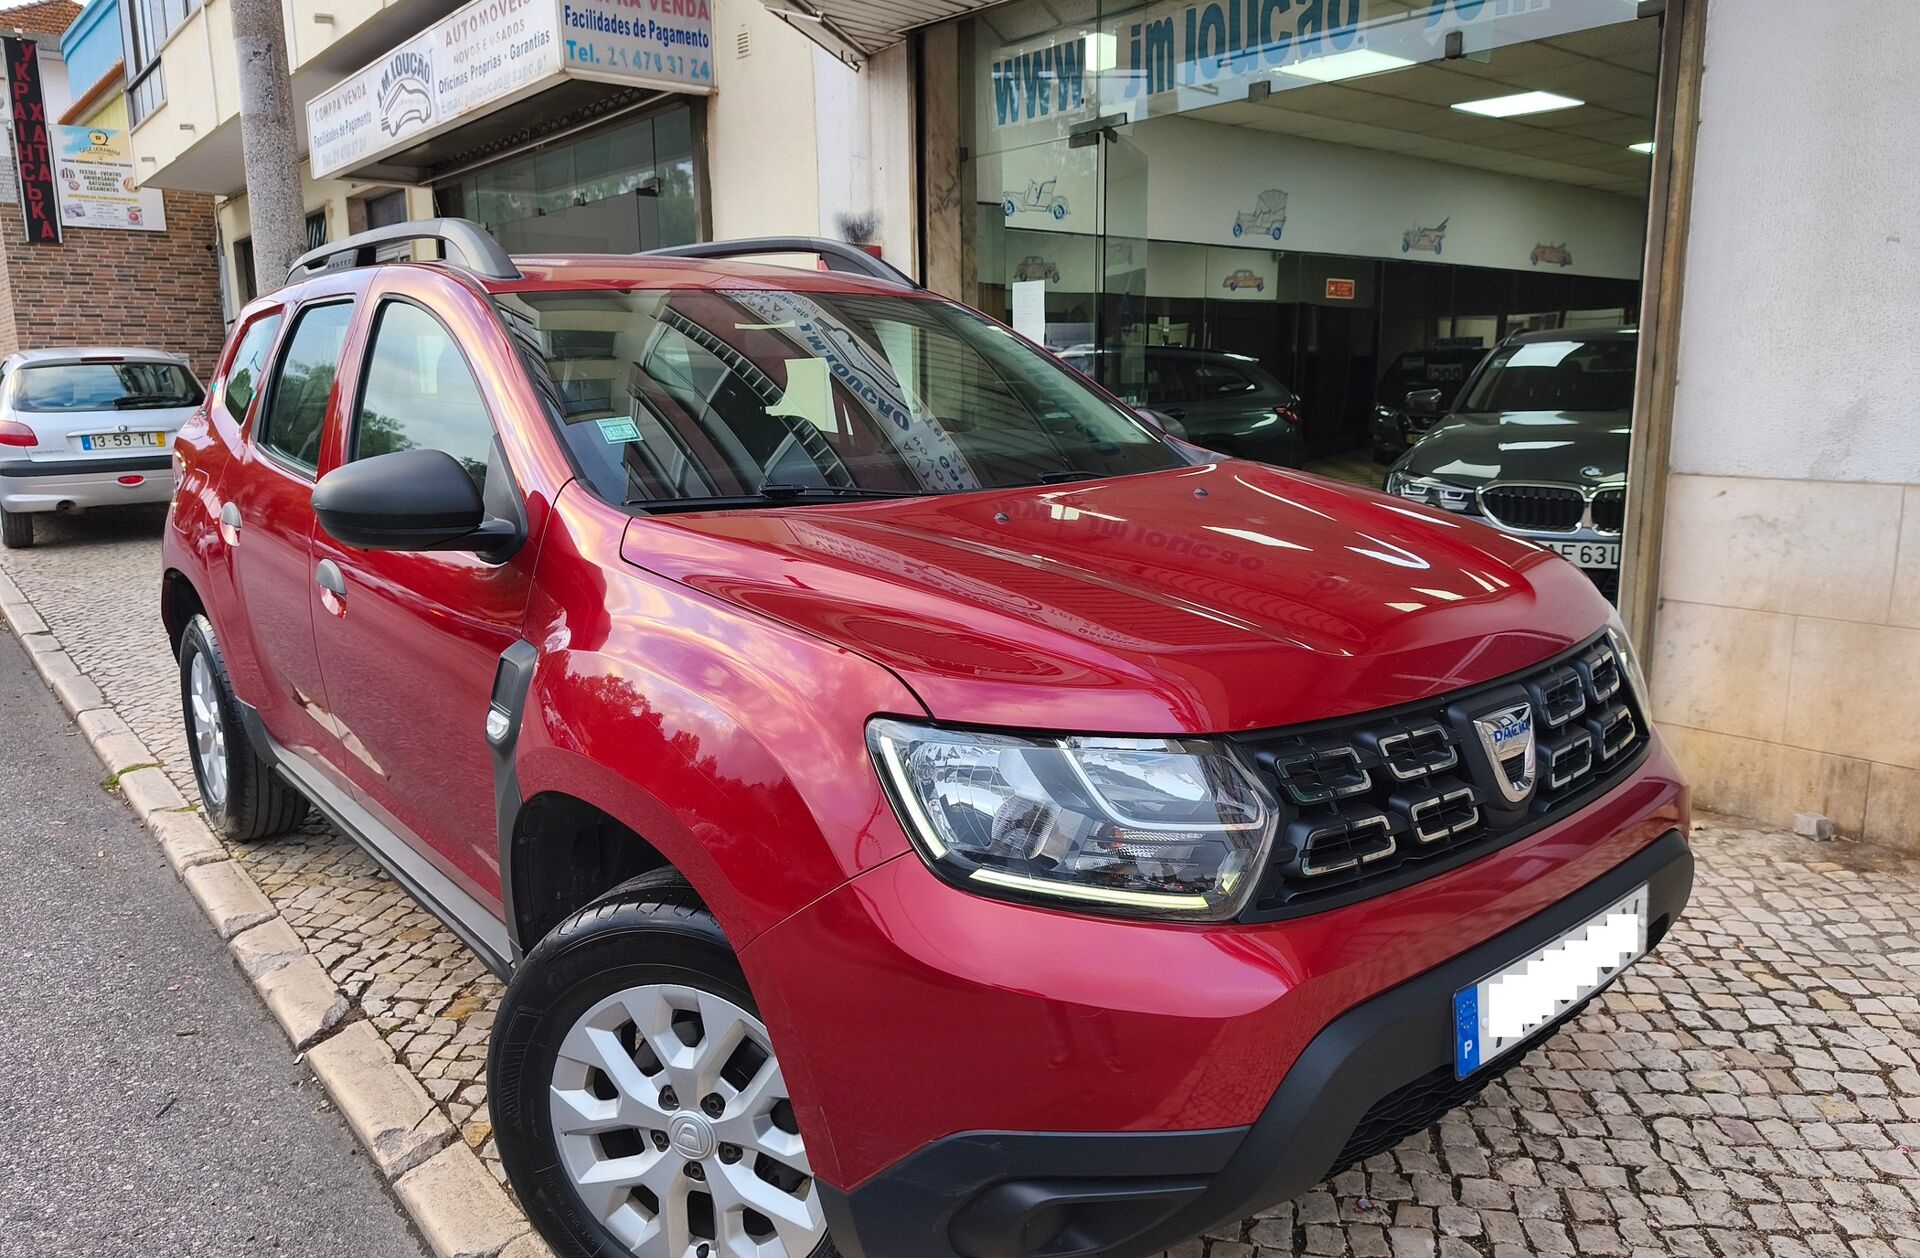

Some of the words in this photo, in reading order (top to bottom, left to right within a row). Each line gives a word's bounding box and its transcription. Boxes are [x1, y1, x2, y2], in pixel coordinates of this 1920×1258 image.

[445, 0, 530, 48] AUTOMOVE
[564, 5, 630, 36] Facilidades
[633, 18, 646, 38] de
[649, 20, 709, 48] Pagamento
[650, 0, 709, 20] VENDA
[453, 42, 480, 65] NOVOS
[490, 18, 525, 46] USADOS
[566, 39, 600, 64] Tel.
[438, 71, 468, 95] Oficinas
[509, 30, 550, 60] Garantias
[315, 100, 341, 122] COMPRA
[342, 83, 367, 106] VENDA
[1464, 1039, 1472, 1059] P
